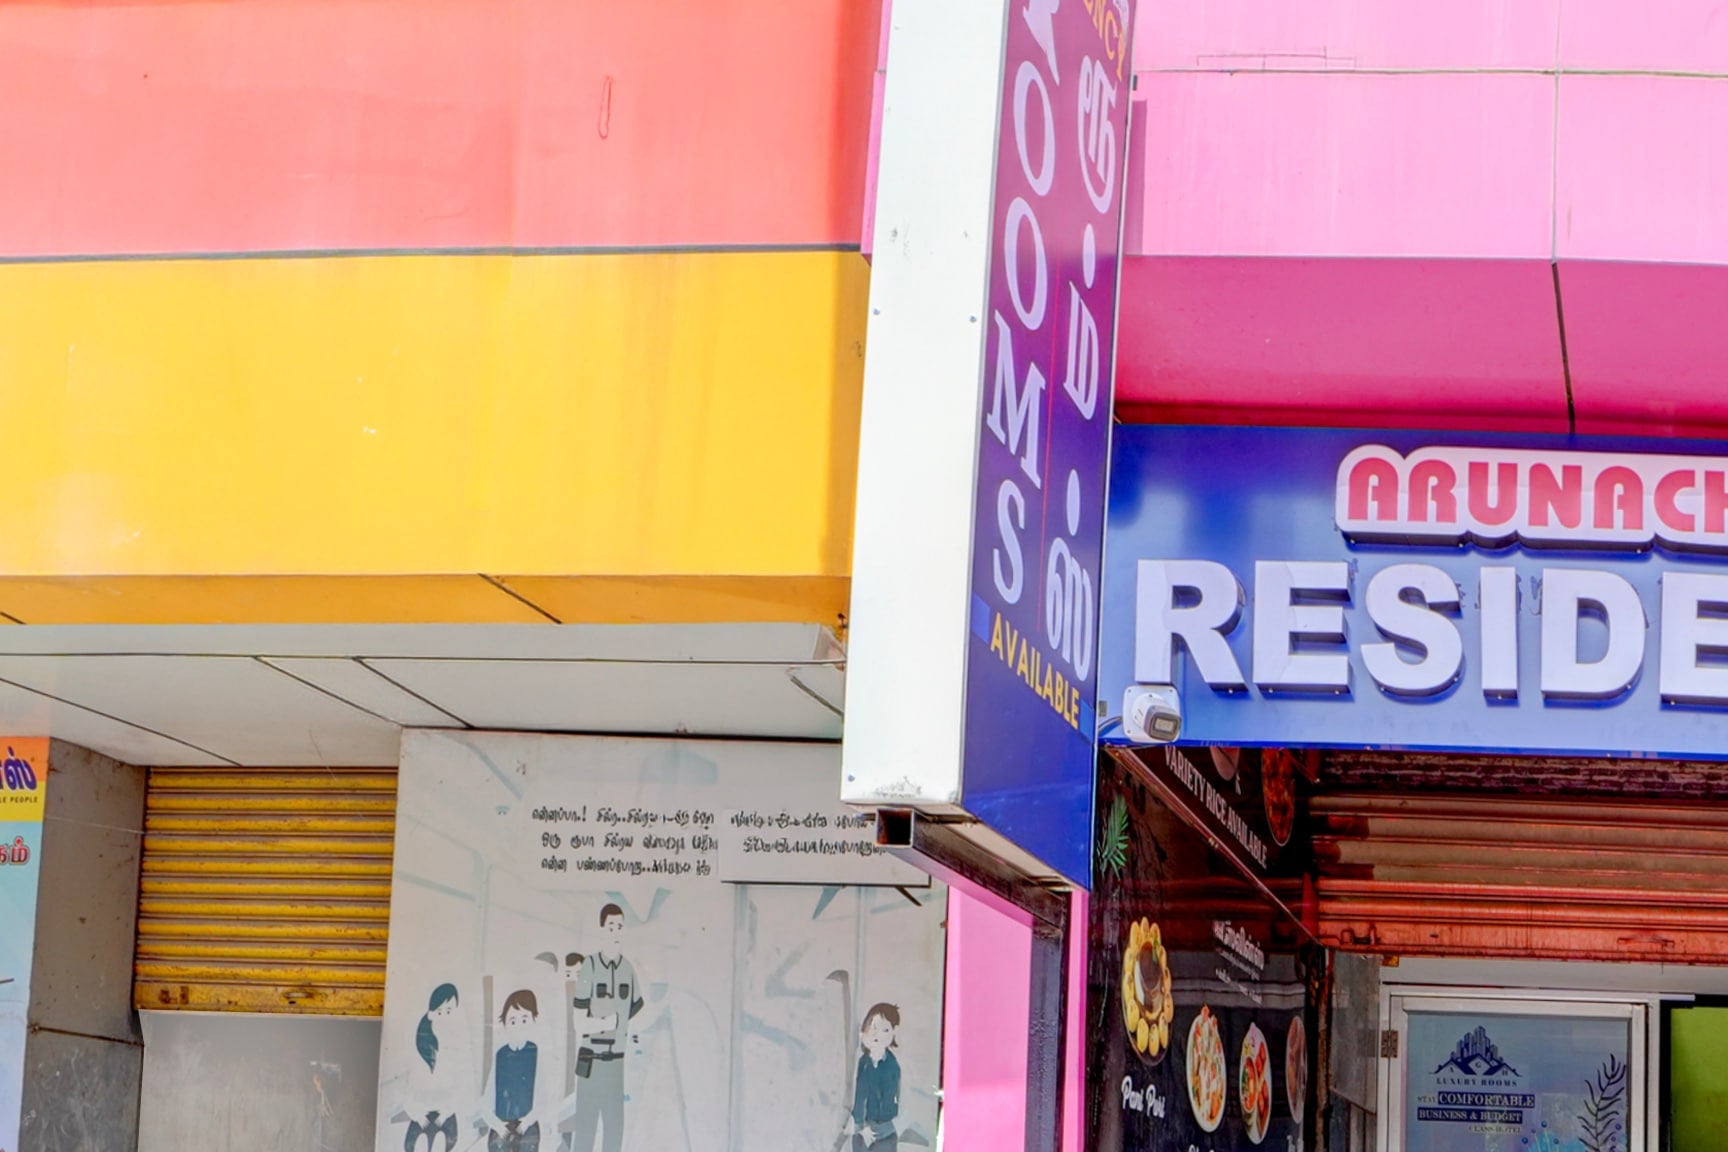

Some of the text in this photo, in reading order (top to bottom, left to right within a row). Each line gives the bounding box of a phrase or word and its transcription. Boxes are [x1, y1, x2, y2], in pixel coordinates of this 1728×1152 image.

[990, 611, 1079, 732] AVAILABLE
[10, 796, 38, 804] PEOPLE
[1165, 744, 1268, 870] VARIETY RICE AVAILABLE
[1436, 1078, 1518, 1087] LUXURY ROOMS
[1439, 1092, 1534, 1107] COMFORTABLE
[1419, 1109, 1522, 1122] BUSINESS & BUDGET
